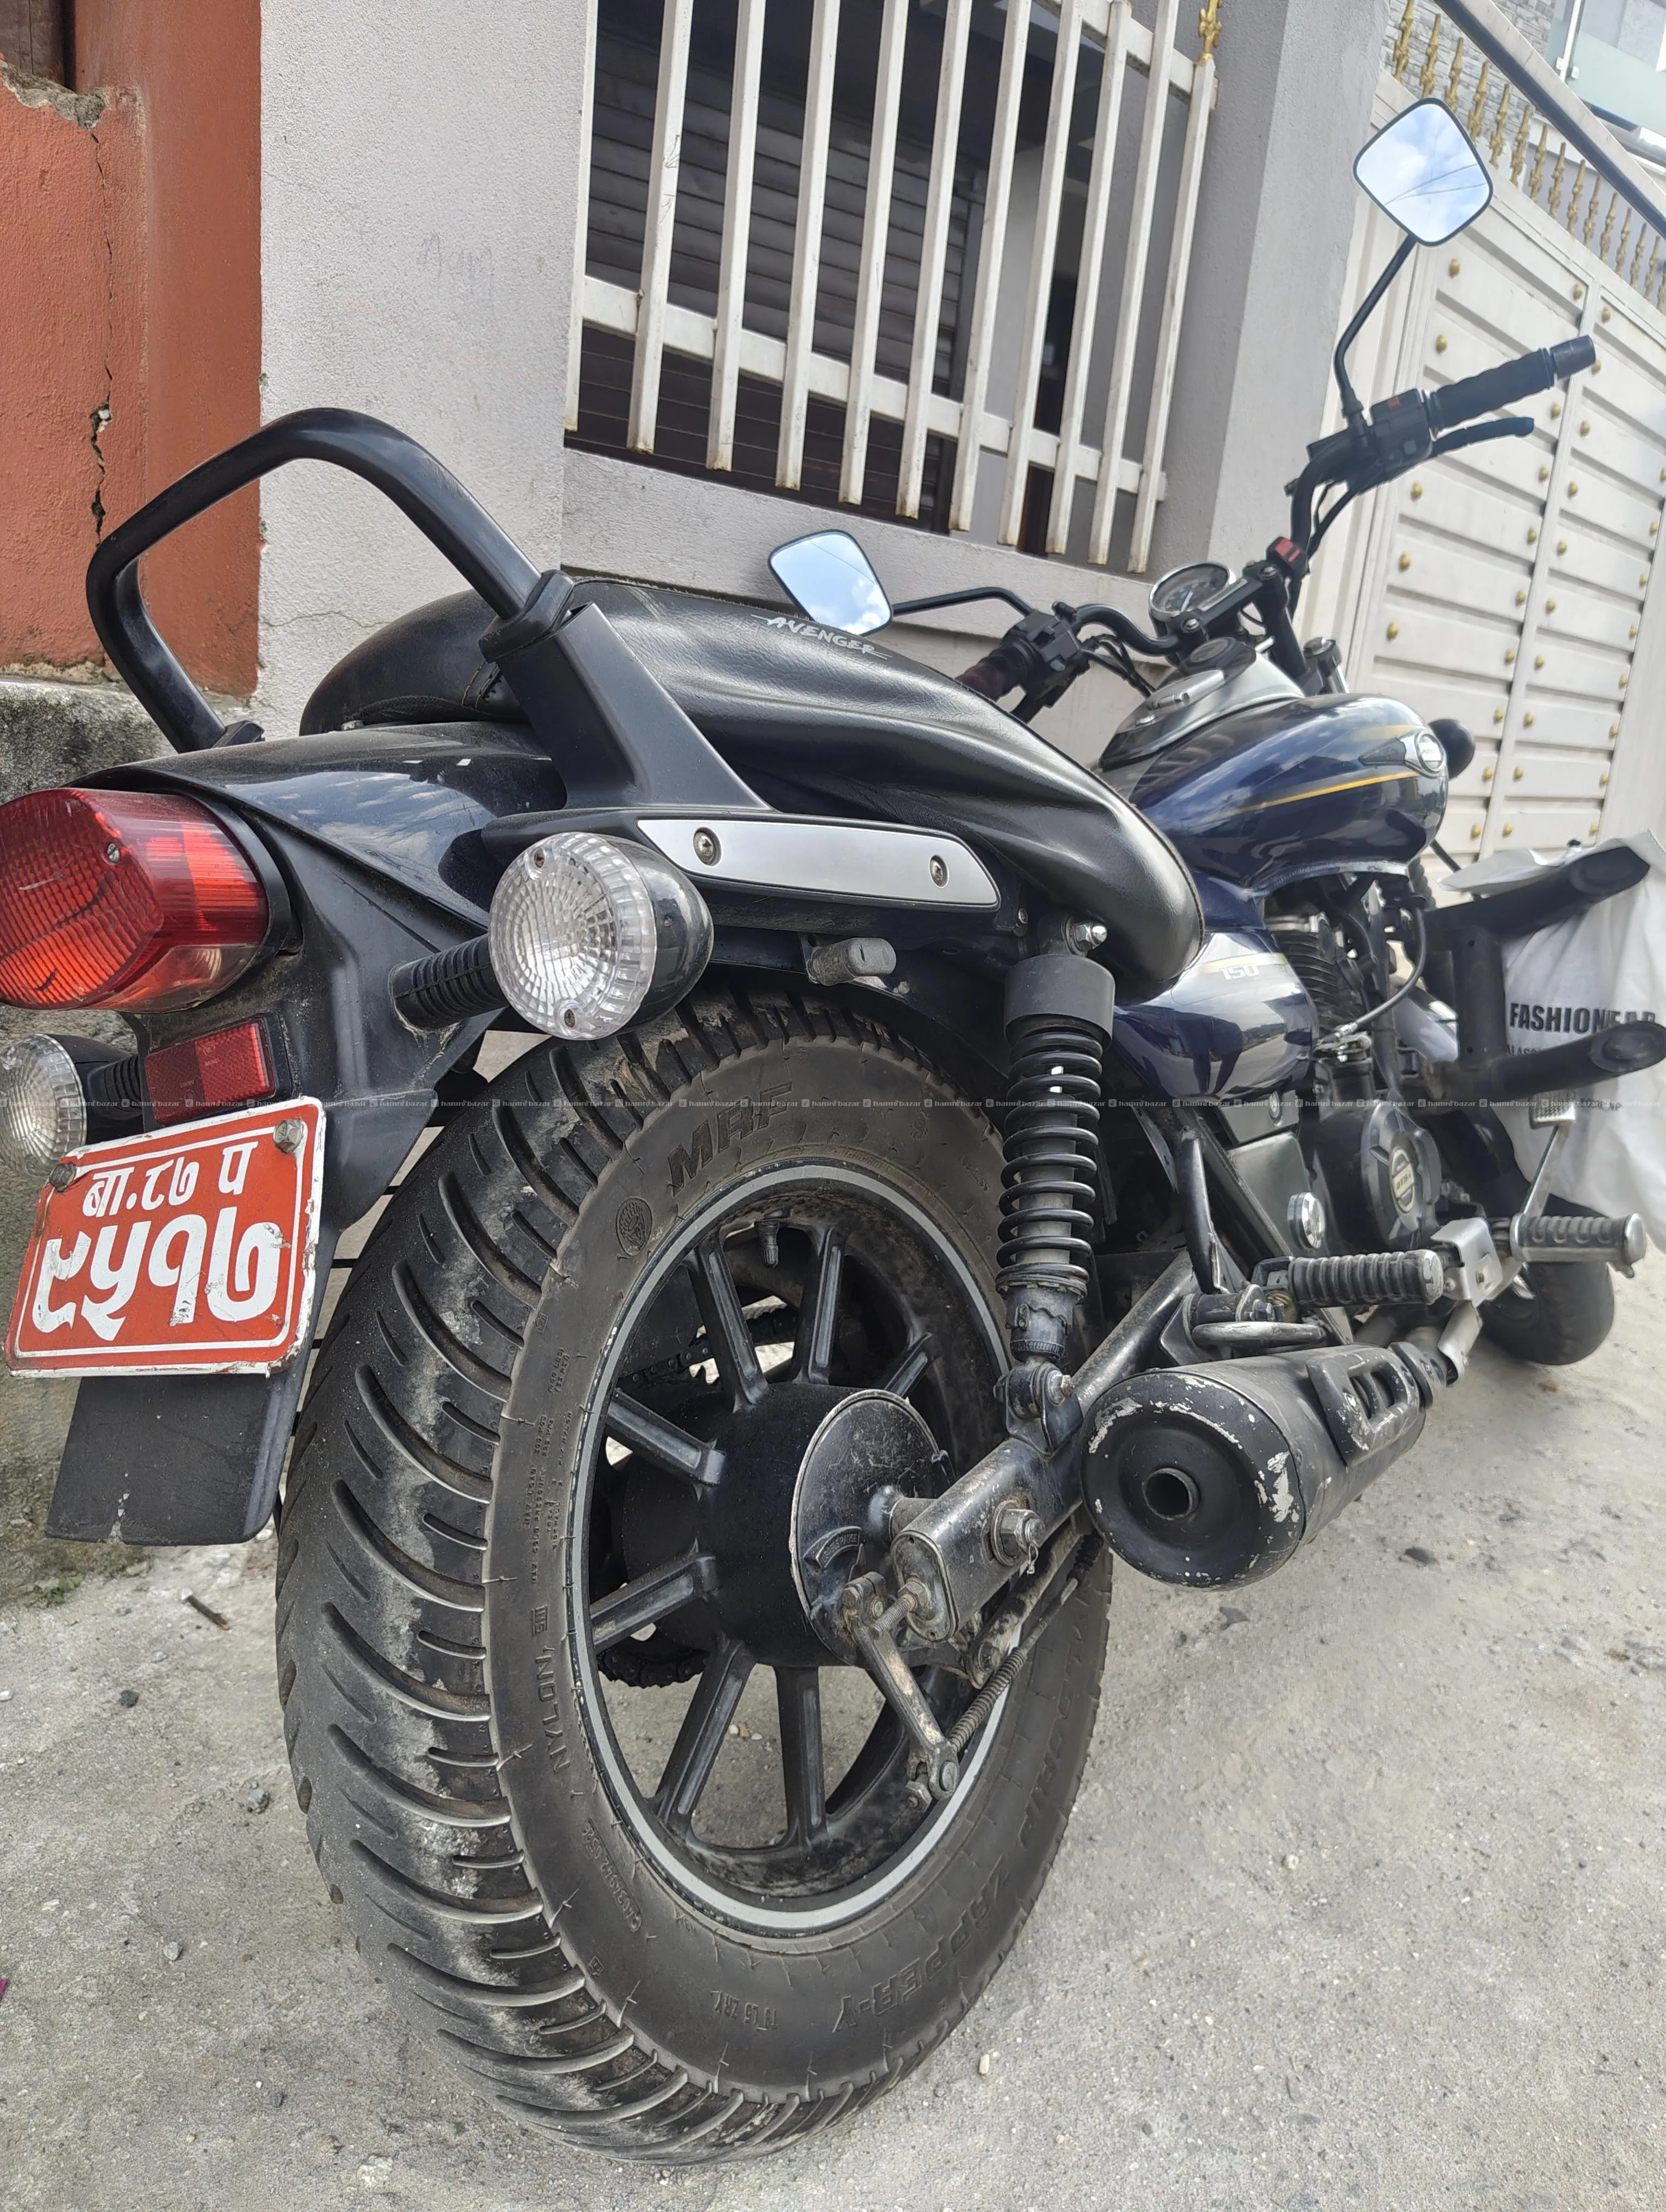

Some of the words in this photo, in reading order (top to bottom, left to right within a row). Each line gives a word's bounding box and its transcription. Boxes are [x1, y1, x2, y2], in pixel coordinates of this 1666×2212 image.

[752, 614, 892, 659] AVENGER
[1219, 964, 1260, 980] 150
[668, 1081, 793, 1197] MRF
[218, 1141, 259, 1195] प
